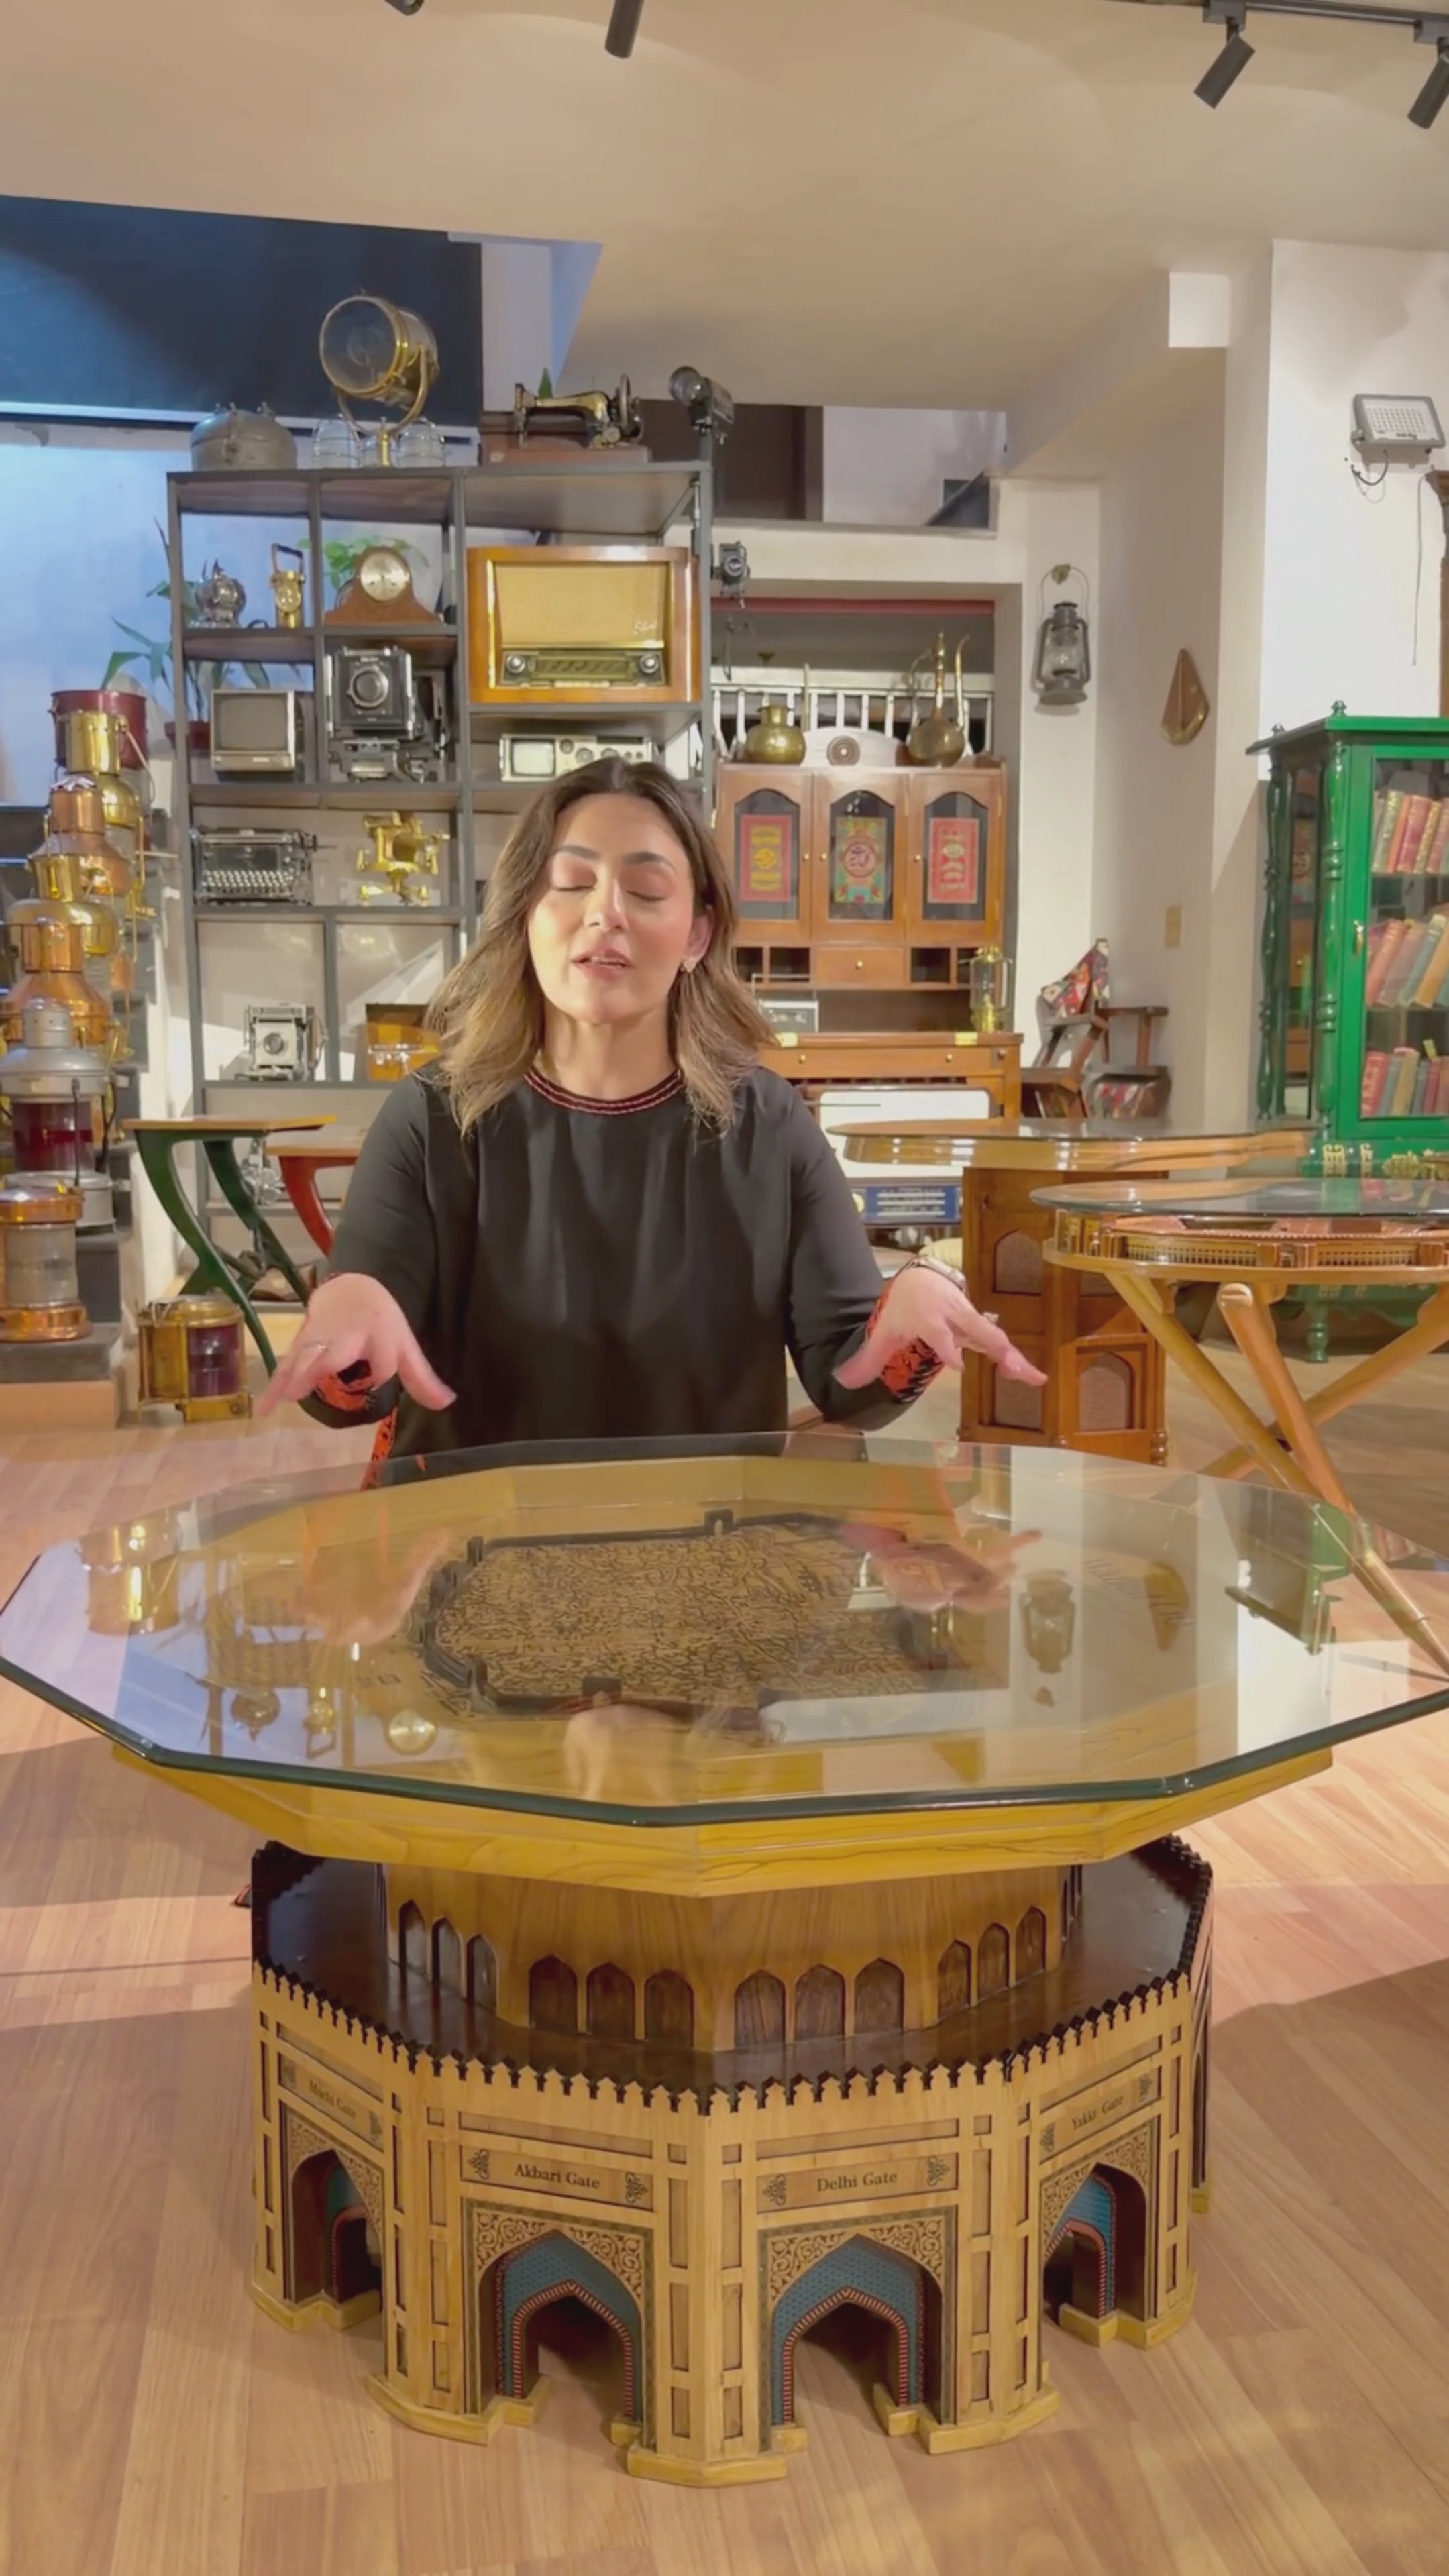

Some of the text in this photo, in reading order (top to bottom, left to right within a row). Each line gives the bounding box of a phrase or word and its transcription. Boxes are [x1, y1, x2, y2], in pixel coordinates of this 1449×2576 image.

[514, 2163, 600, 2189] Akbari Gate
[816, 2171, 898, 2192] Delhi Gate
